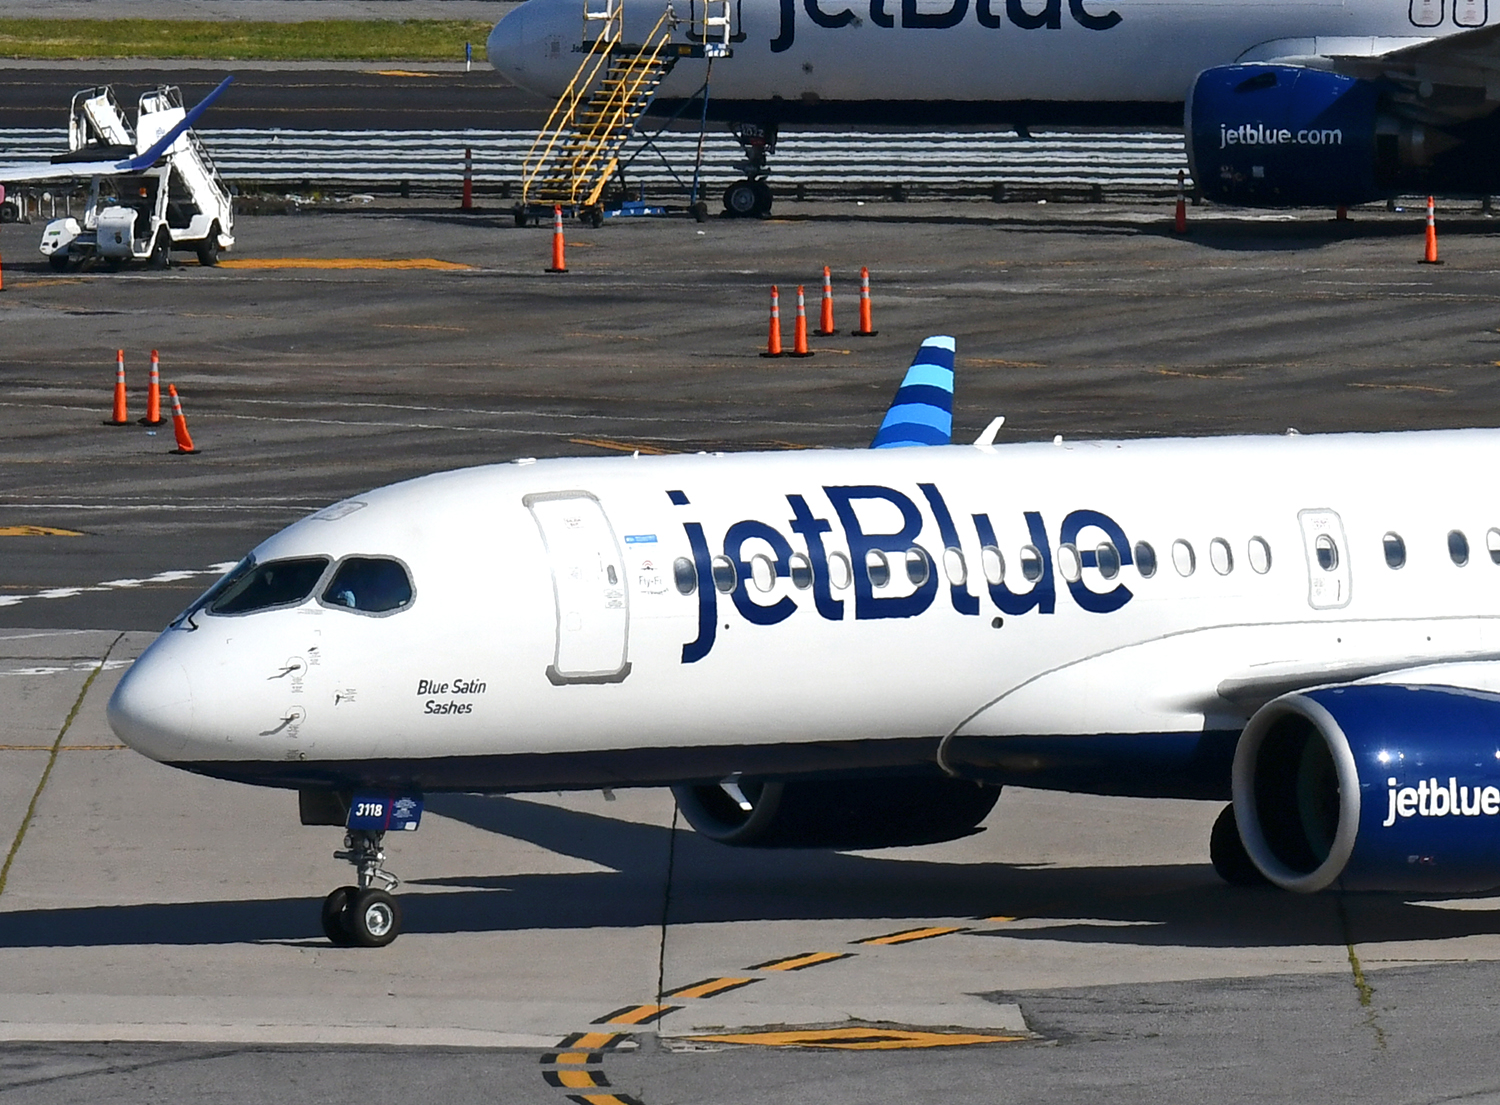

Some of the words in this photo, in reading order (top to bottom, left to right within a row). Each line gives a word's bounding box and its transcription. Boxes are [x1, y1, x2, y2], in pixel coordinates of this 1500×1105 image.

[1220, 123, 1343, 149] jetblue.com
[665, 482, 1135, 663] jetBlue
[417, 679, 449, 696] Blue
[451, 678, 487, 694] Satin
[424, 699, 473, 715] Sashes
[355, 803, 383, 817] 3118
